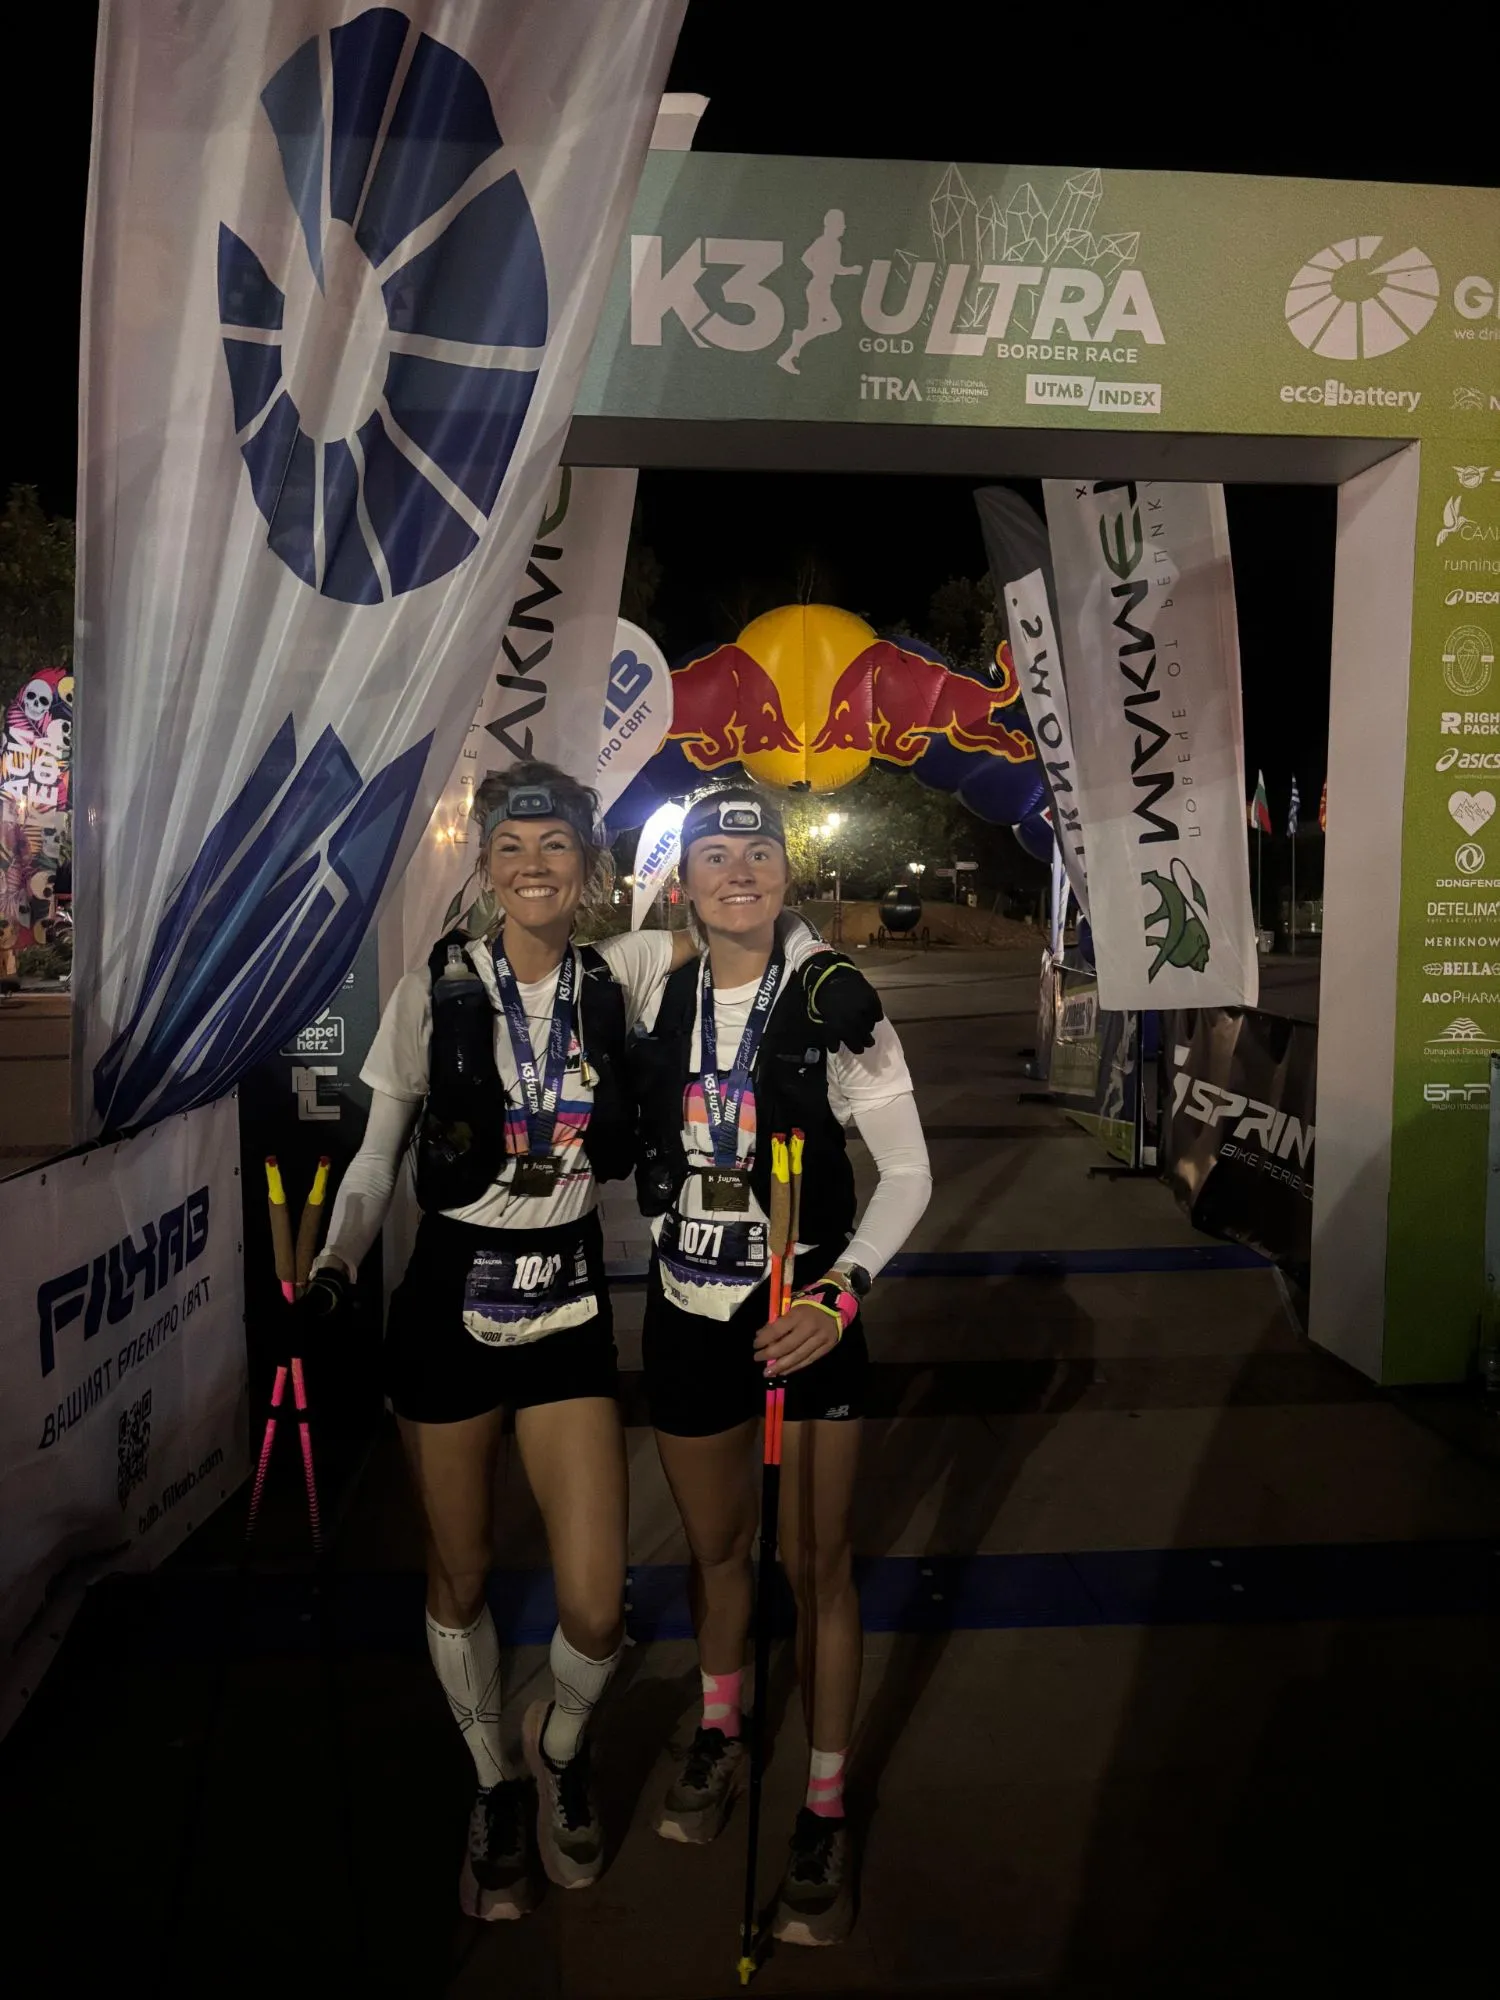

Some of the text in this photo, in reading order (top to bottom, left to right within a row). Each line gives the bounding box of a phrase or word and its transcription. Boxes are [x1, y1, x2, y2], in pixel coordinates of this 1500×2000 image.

[630, 235, 1166, 356] K3 ULTRA
[859, 338, 914, 354] GOLD
[997, 343, 1138, 364] BORDER RACE
[926, 379, 988, 388] INTERNATIONAL
[926, 387, 989, 396] TRAIL RUNNING
[1034, 381, 1156, 407] UTMB INDEX
[926, 395, 979, 404] ASSOCIATION
[1444, 559, 1500, 575] running
[1465, 592, 1500, 604] DECA
[618, 702, 653, 740] СВЯТ
[1427, 902, 1498, 916] DETELINA
[496, 957, 511, 978] 100K
[562, 957, 574, 983] ULTRA
[1443, 961, 1492, 976] BELLA
[755, 964, 779, 1011] K3 ULTRA
[297, 1038, 329, 1051] herz
[520, 1061, 539, 1114] K3 ULTRA
[541, 1087, 558, 1112] 100K
[703, 1072, 721, 1126] K3 ULTRA
[722, 1099, 738, 1123] 100K
[1219, 1143, 1260, 1169] BIKE
[678, 1220, 724, 1258] 1071
[37, 1185, 210, 1378] FILKAB
[38, 1356, 113, 1450] ВАШИЯТ
